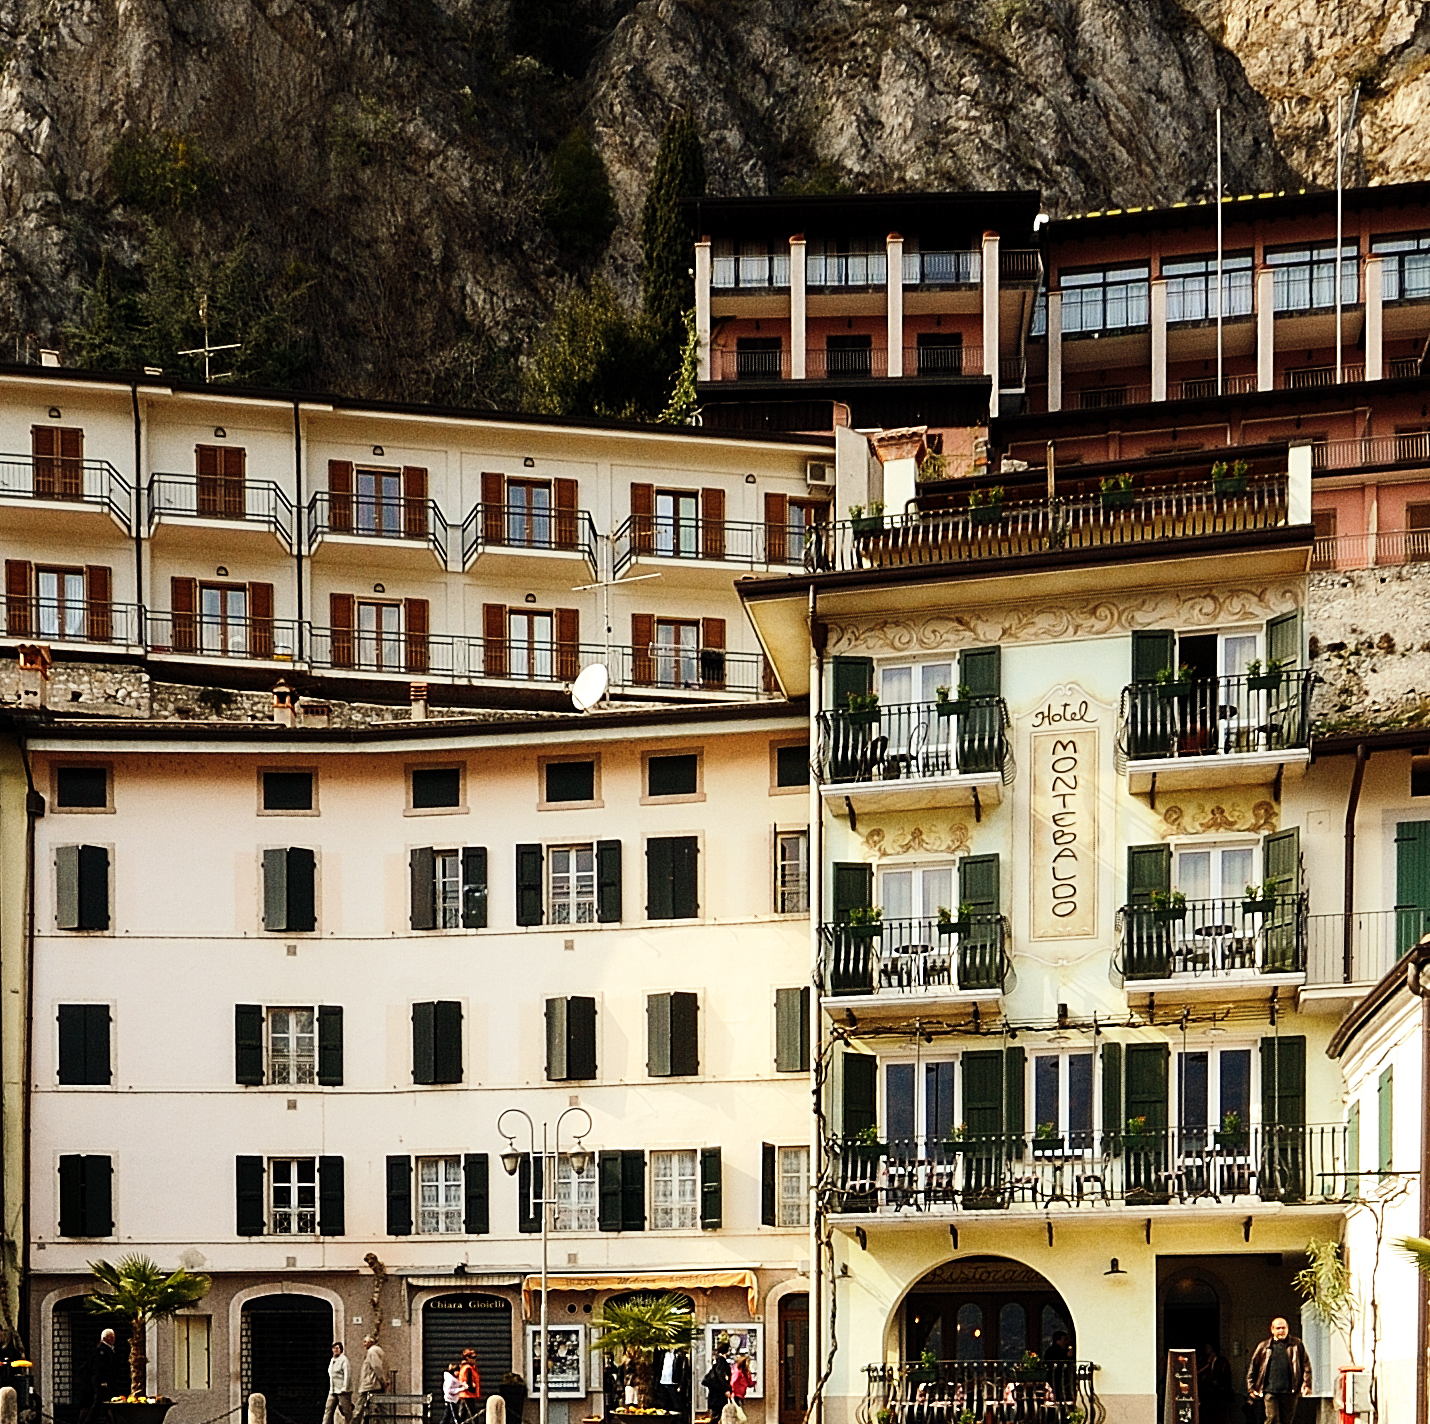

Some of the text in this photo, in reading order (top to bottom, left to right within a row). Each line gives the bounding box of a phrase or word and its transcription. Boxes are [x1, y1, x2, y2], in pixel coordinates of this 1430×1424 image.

[1032, 701, 1098, 727] Hotel
[1051, 739, 1078, 917] MONTEBALDO
[430, 1301, 463, 1309] Chiara
